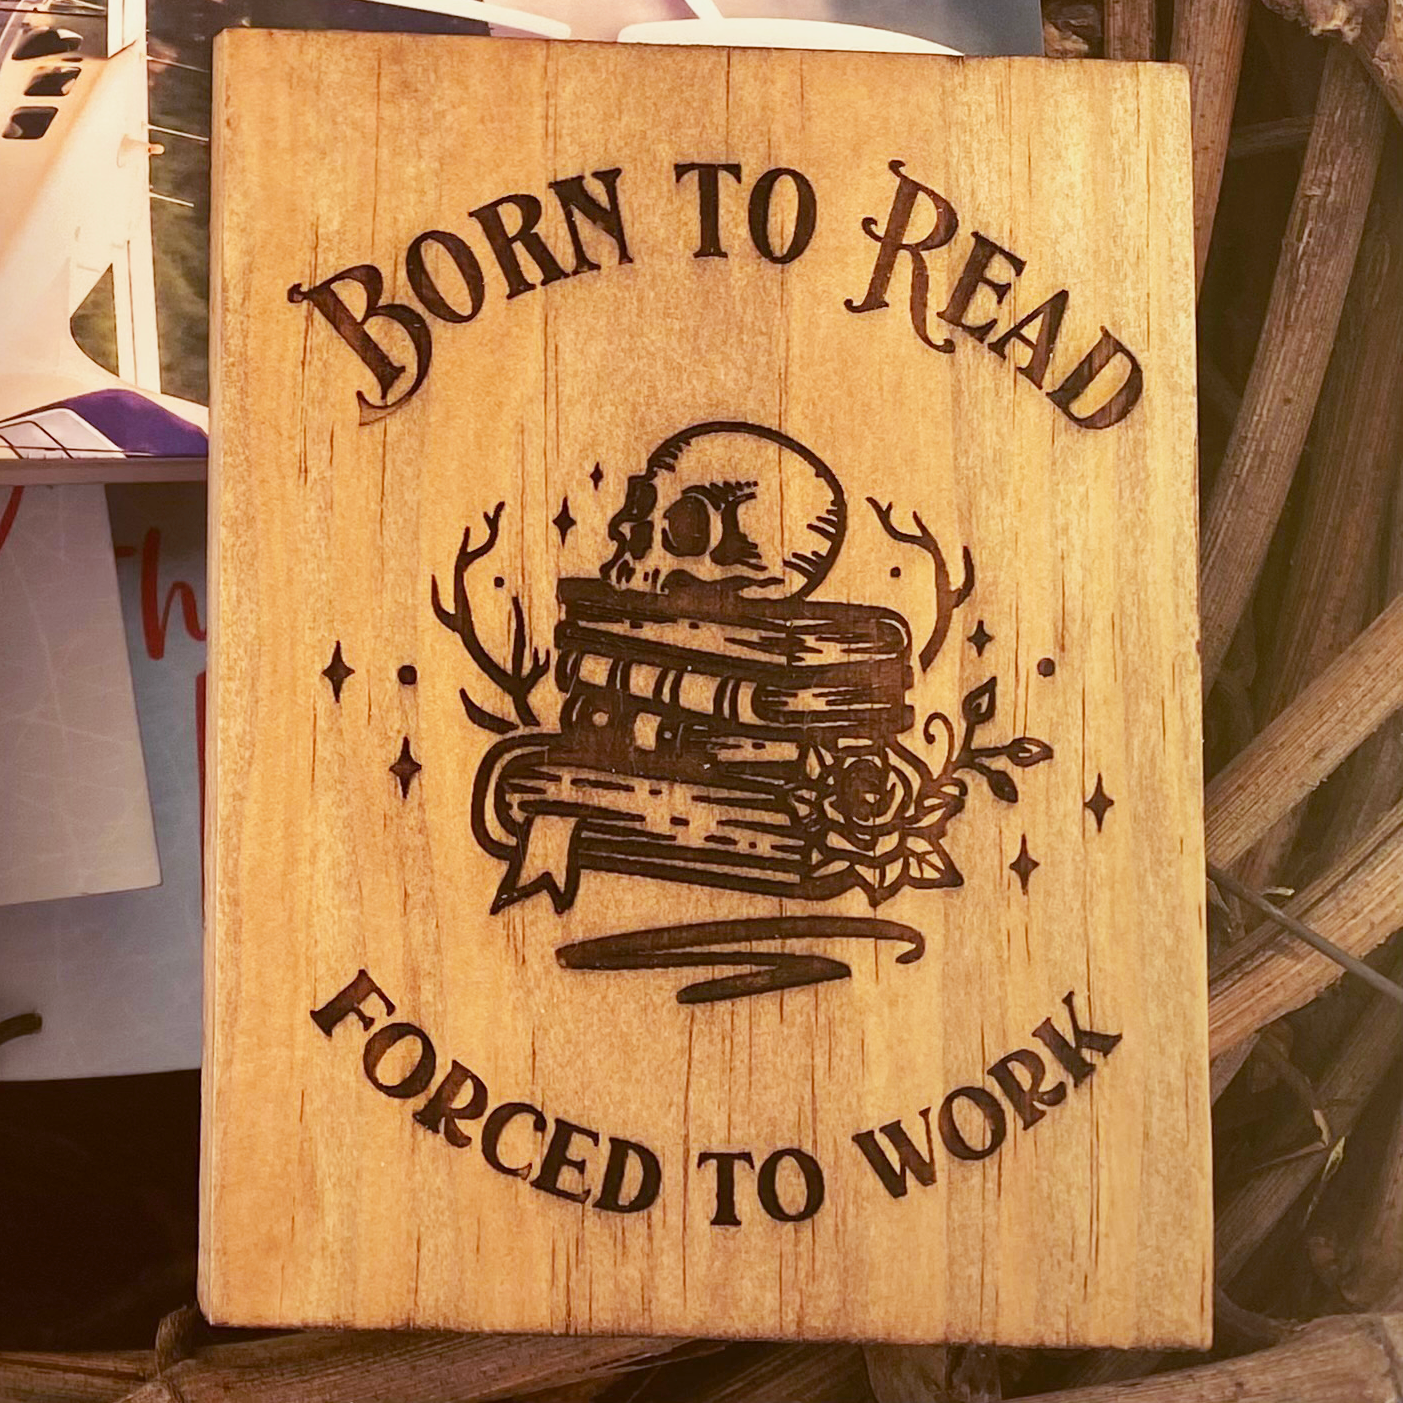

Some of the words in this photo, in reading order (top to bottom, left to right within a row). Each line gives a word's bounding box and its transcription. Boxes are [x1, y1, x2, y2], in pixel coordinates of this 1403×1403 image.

[286, 168, 637, 428] BORN
[674, 162, 817, 266] TO
[845, 159, 1145, 431] READ
[309, 968, 663, 1215] FORCED
[698, 1147, 826, 1227] TO
[852, 990, 1124, 1199] WORK
